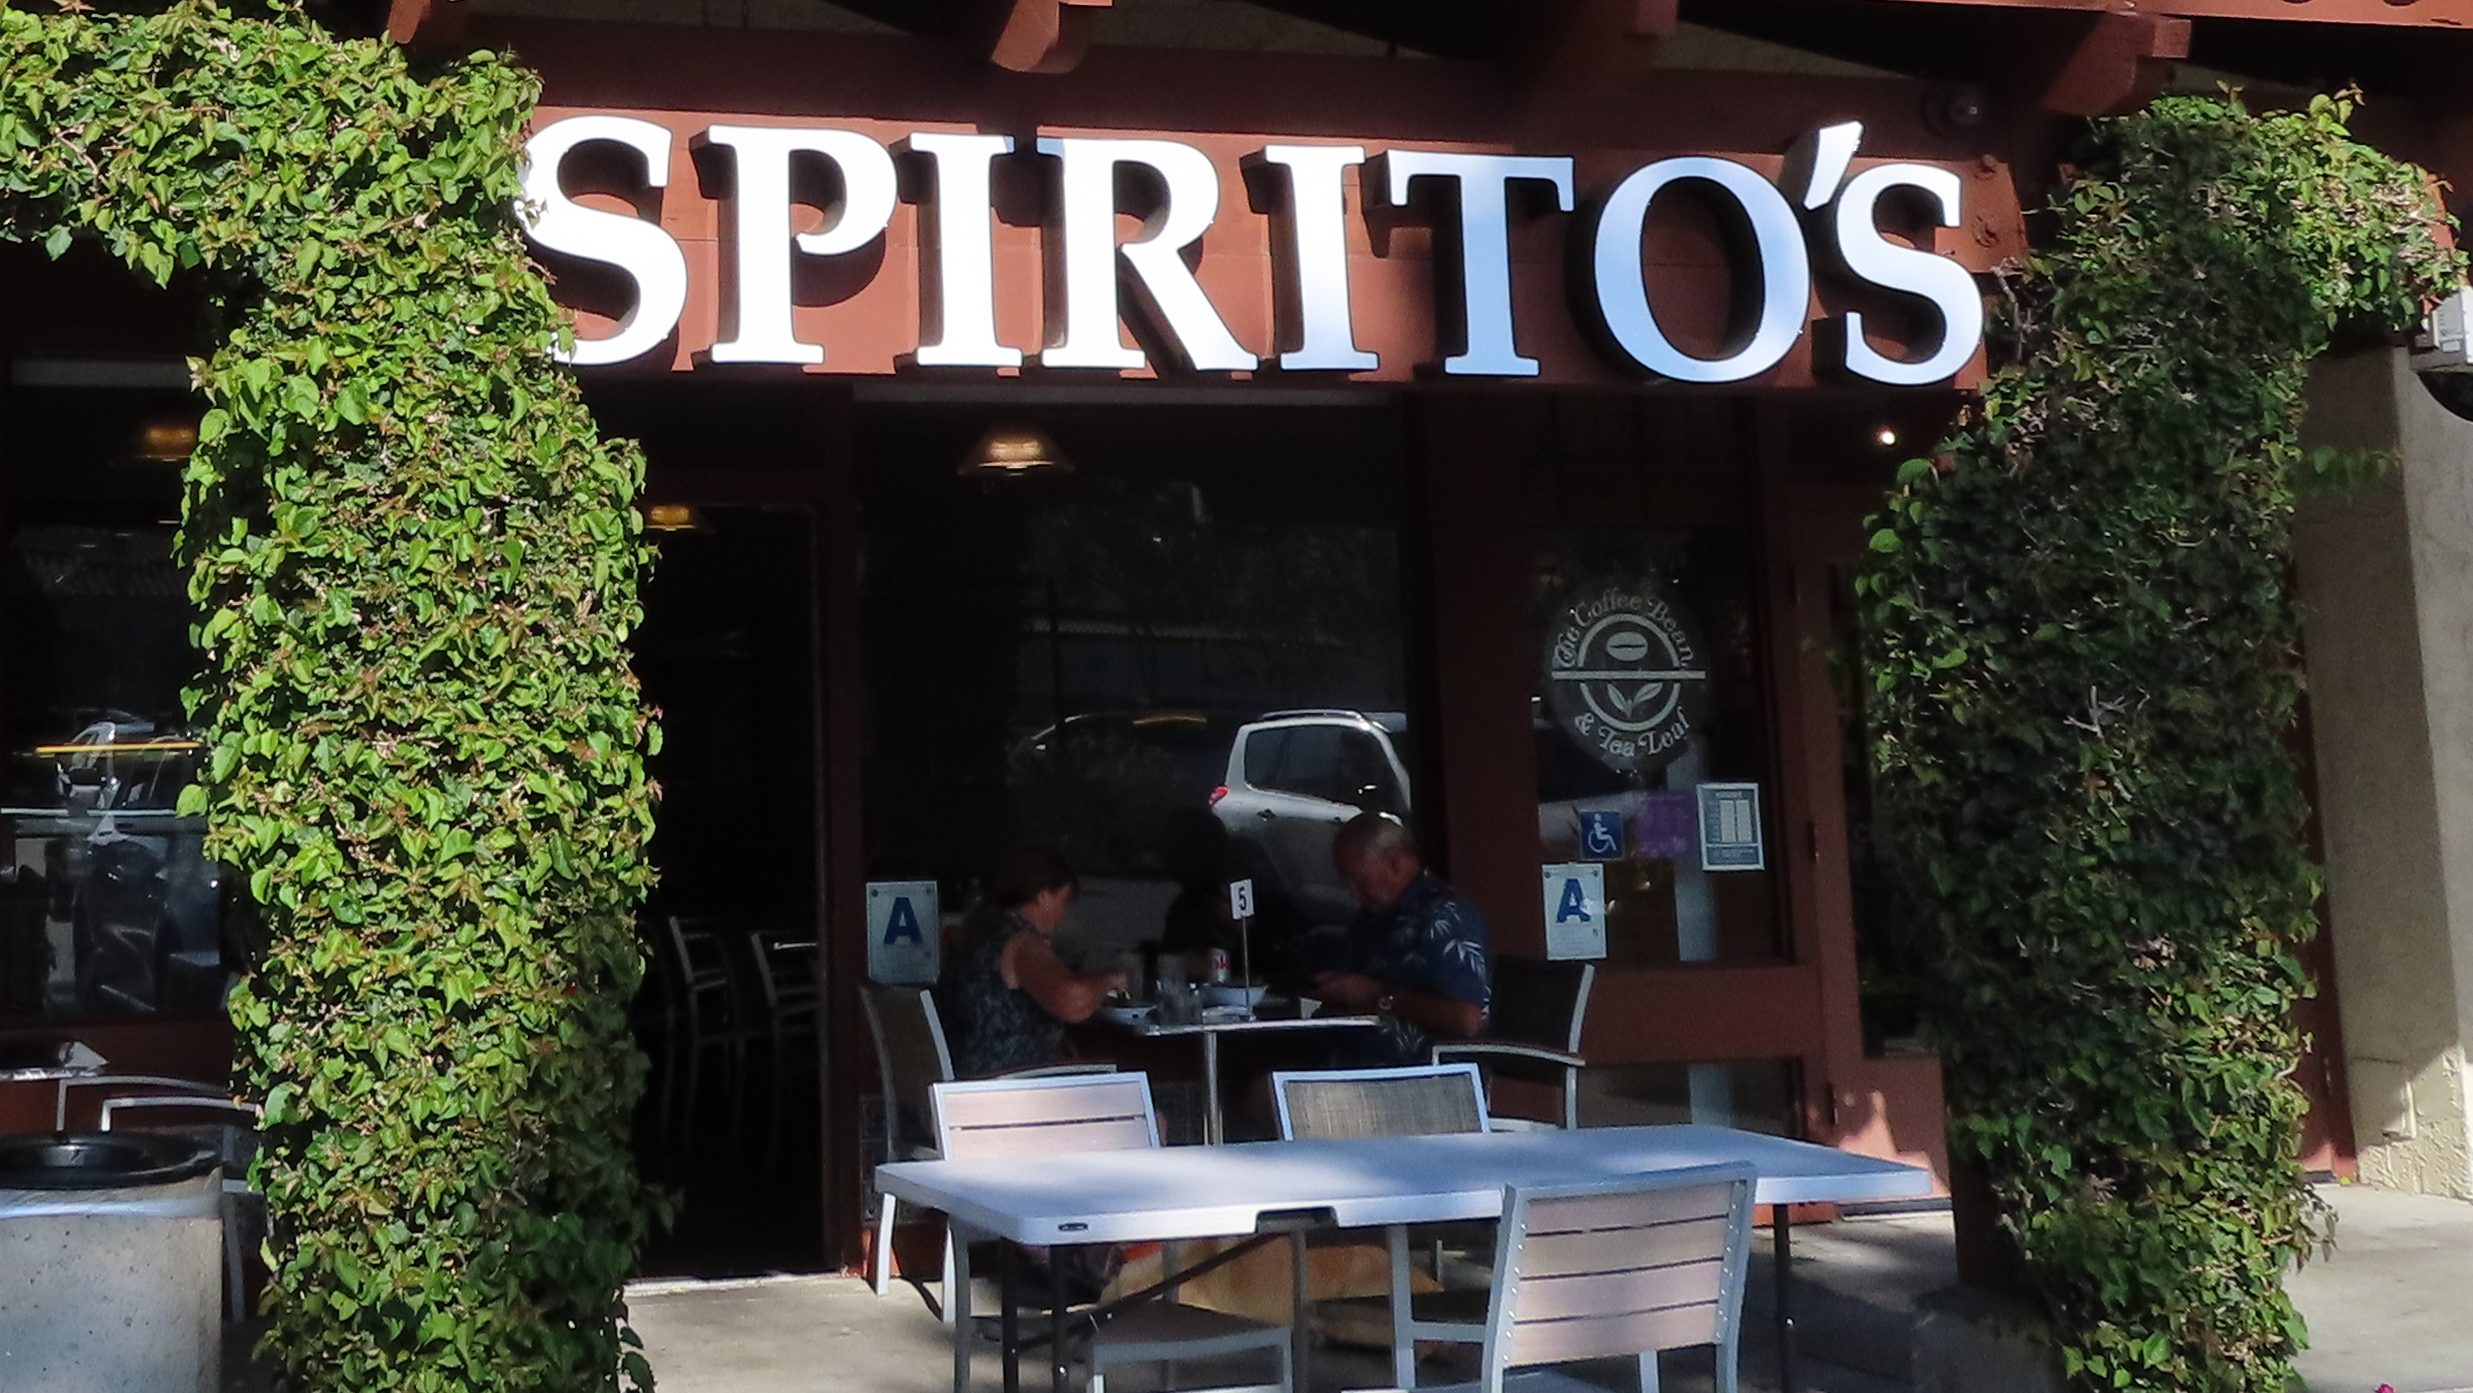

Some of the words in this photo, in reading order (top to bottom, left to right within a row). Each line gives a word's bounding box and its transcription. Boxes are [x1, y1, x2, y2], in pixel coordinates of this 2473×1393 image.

[514, 114, 1984, 387] SPIRITO'S
[1553, 626, 1581, 668] The
[1571, 587, 1642, 627] Coffee
[1648, 597, 1695, 667] Bean
[1574, 712, 1595, 736] &
[1598, 726, 1635, 757] Tea
[1637, 705, 1690, 755] Leaf
[883, 896, 924, 945] A
[1237, 886, 1248, 911] 5
[1555, 878, 1592, 924] A
